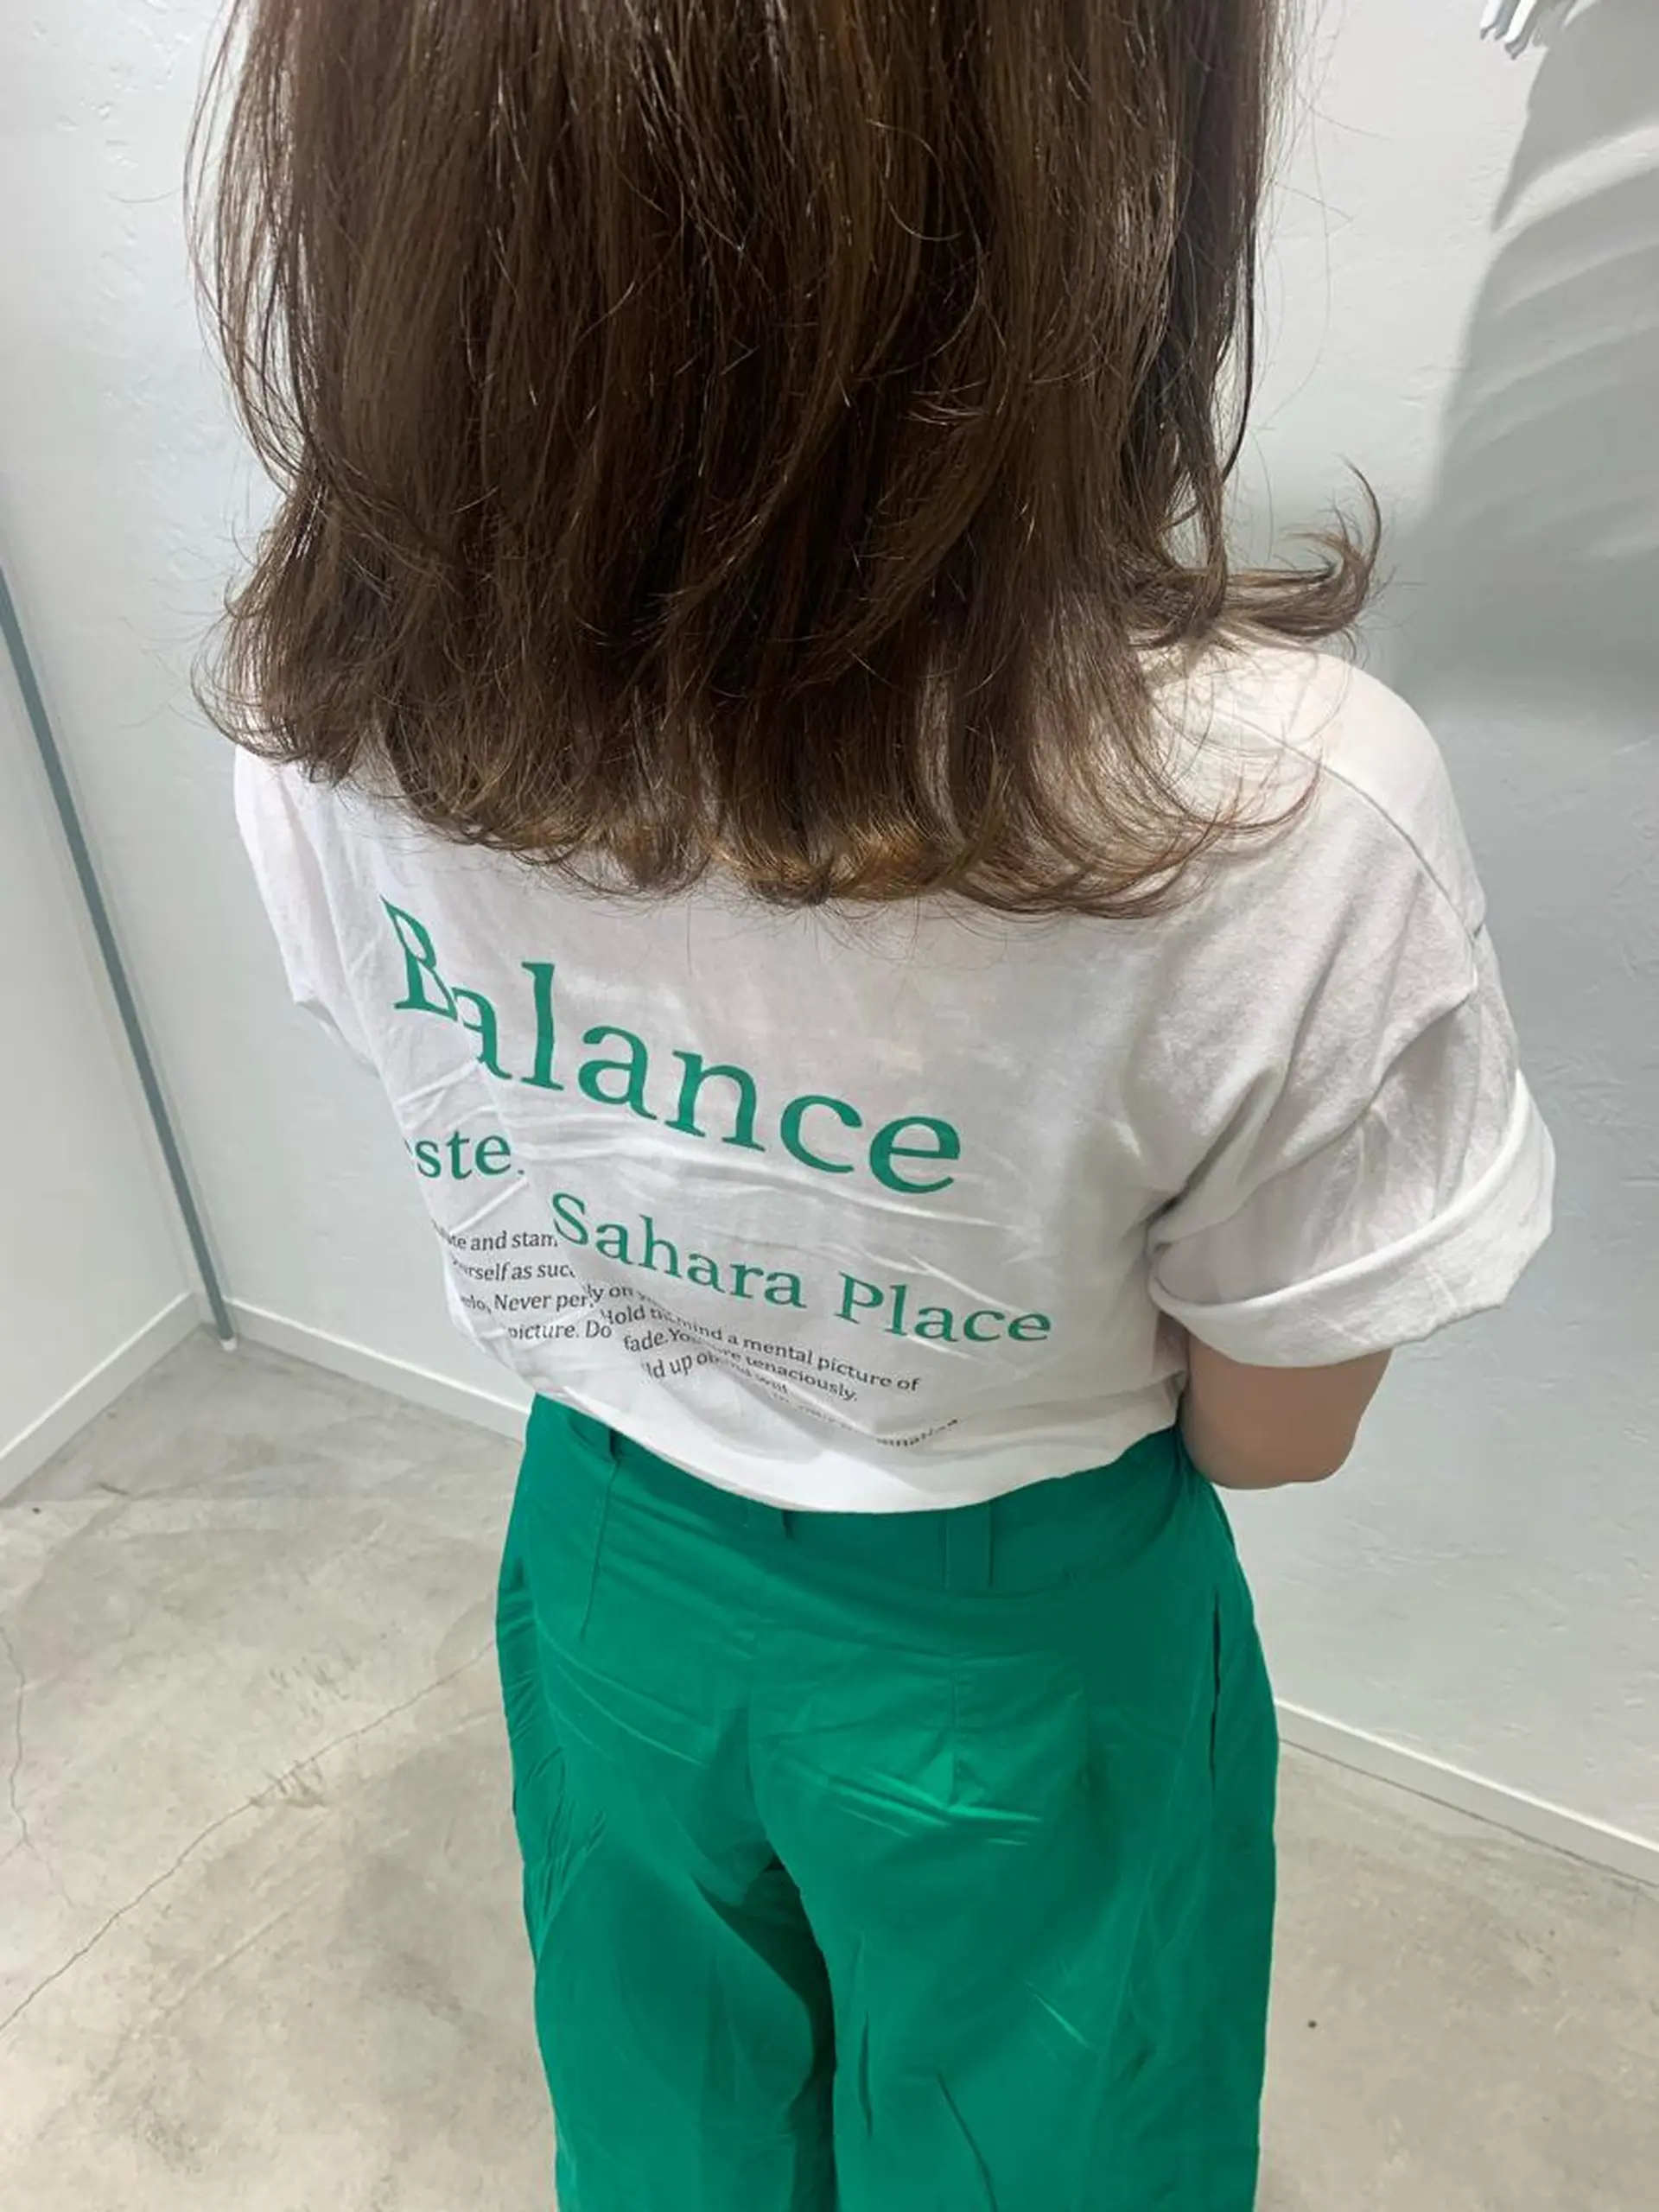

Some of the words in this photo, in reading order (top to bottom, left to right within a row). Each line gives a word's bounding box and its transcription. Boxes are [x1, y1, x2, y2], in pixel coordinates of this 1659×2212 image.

[380, 894, 962, 1193] Balance
[470, 1230, 507, 1250] and
[512, 1231, 558, 1249] stam
[728, 1335, 739, 1345] a
[742, 1338, 814, 1365] mental
[817, 1355, 893, 1388] picture
[897, 1377, 920, 1392] of
[494, 1294, 552, 1312] Never
[512, 1265, 533, 1280] as
[745, 1355, 858, 1402] tenaciously.
[551, 1192, 807, 1308] Sahara
[836, 1270, 1052, 1344] Place
[584, 1319, 613, 1340] Do
[670, 1354, 693, 1376] up
